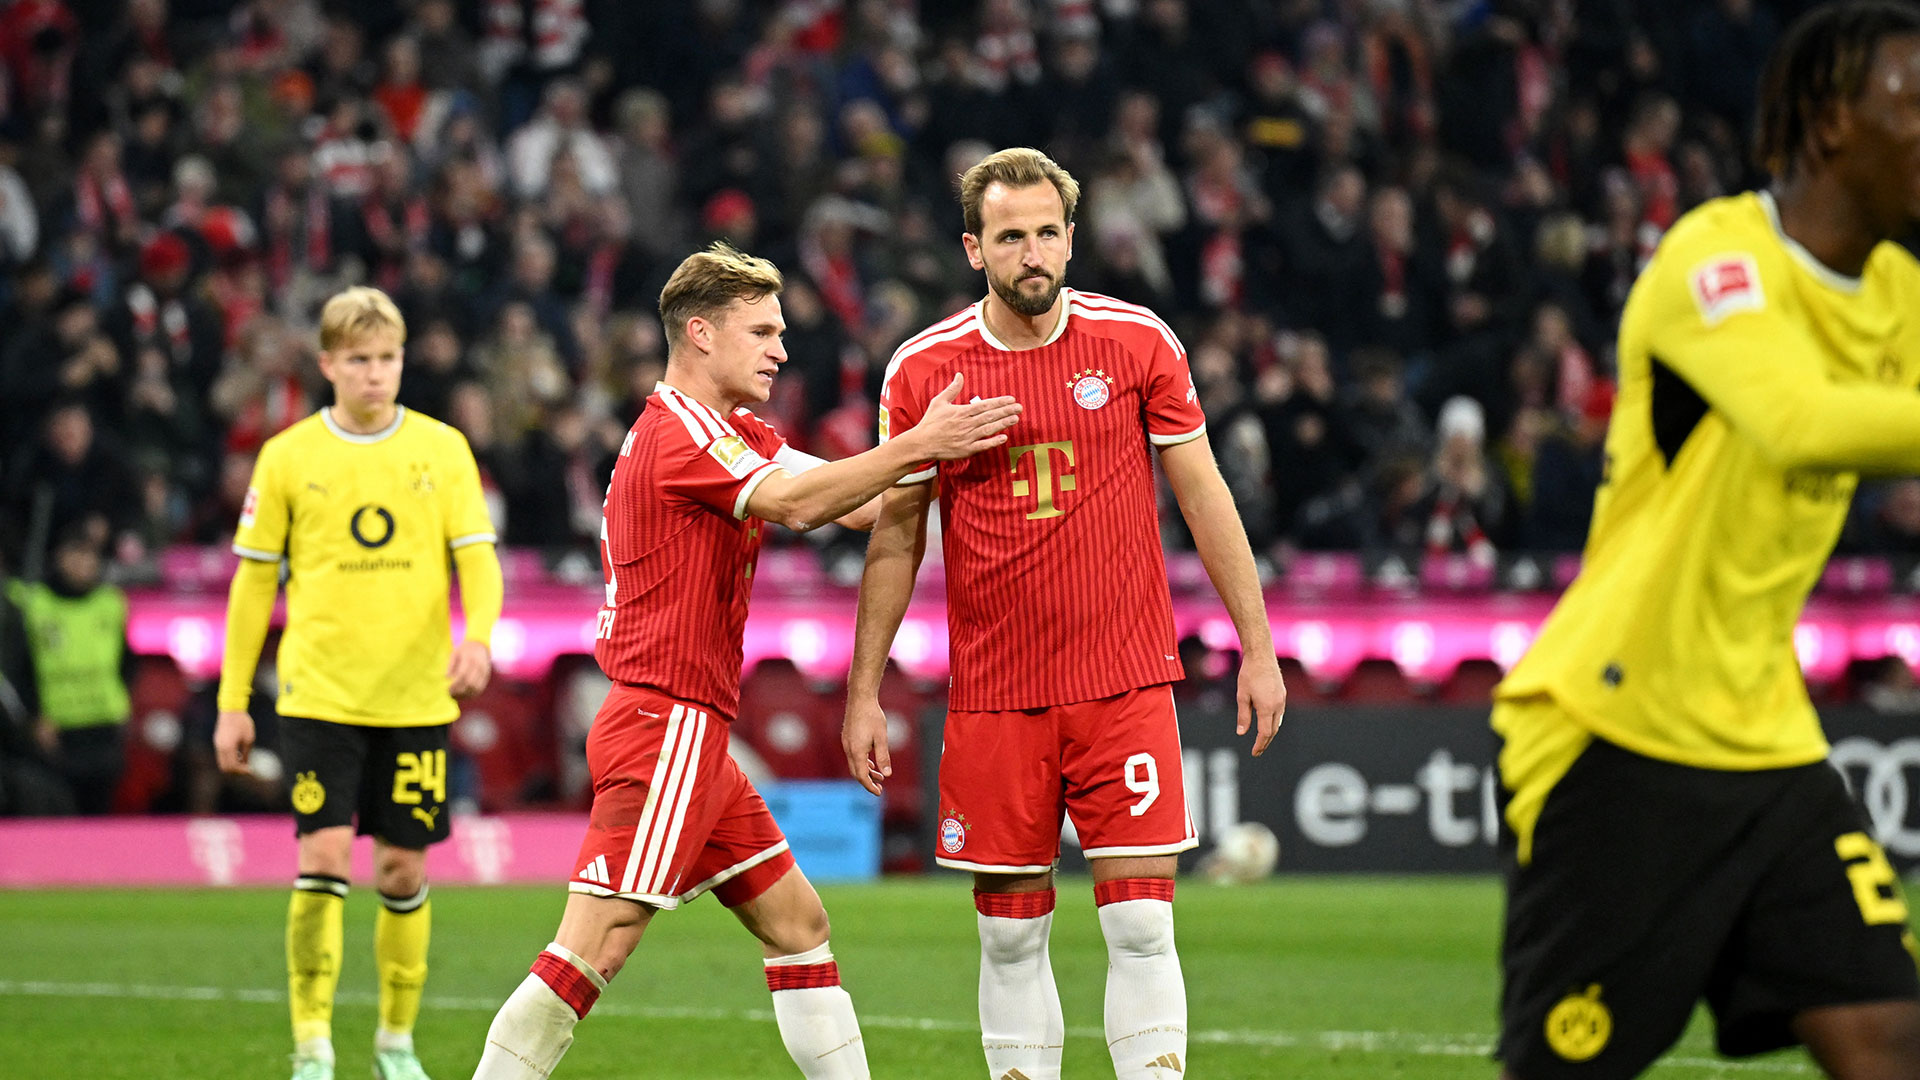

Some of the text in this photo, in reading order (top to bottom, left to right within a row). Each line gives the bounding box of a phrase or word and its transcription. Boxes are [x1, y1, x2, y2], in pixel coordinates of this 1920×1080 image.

[1009, 440, 1077, 520] T
[391, 748, 447, 804] 24
[1124, 752, 1161, 817] 9
[1834, 831, 1909, 926] 2
[1138, 1026, 1159, 1037] MIA
